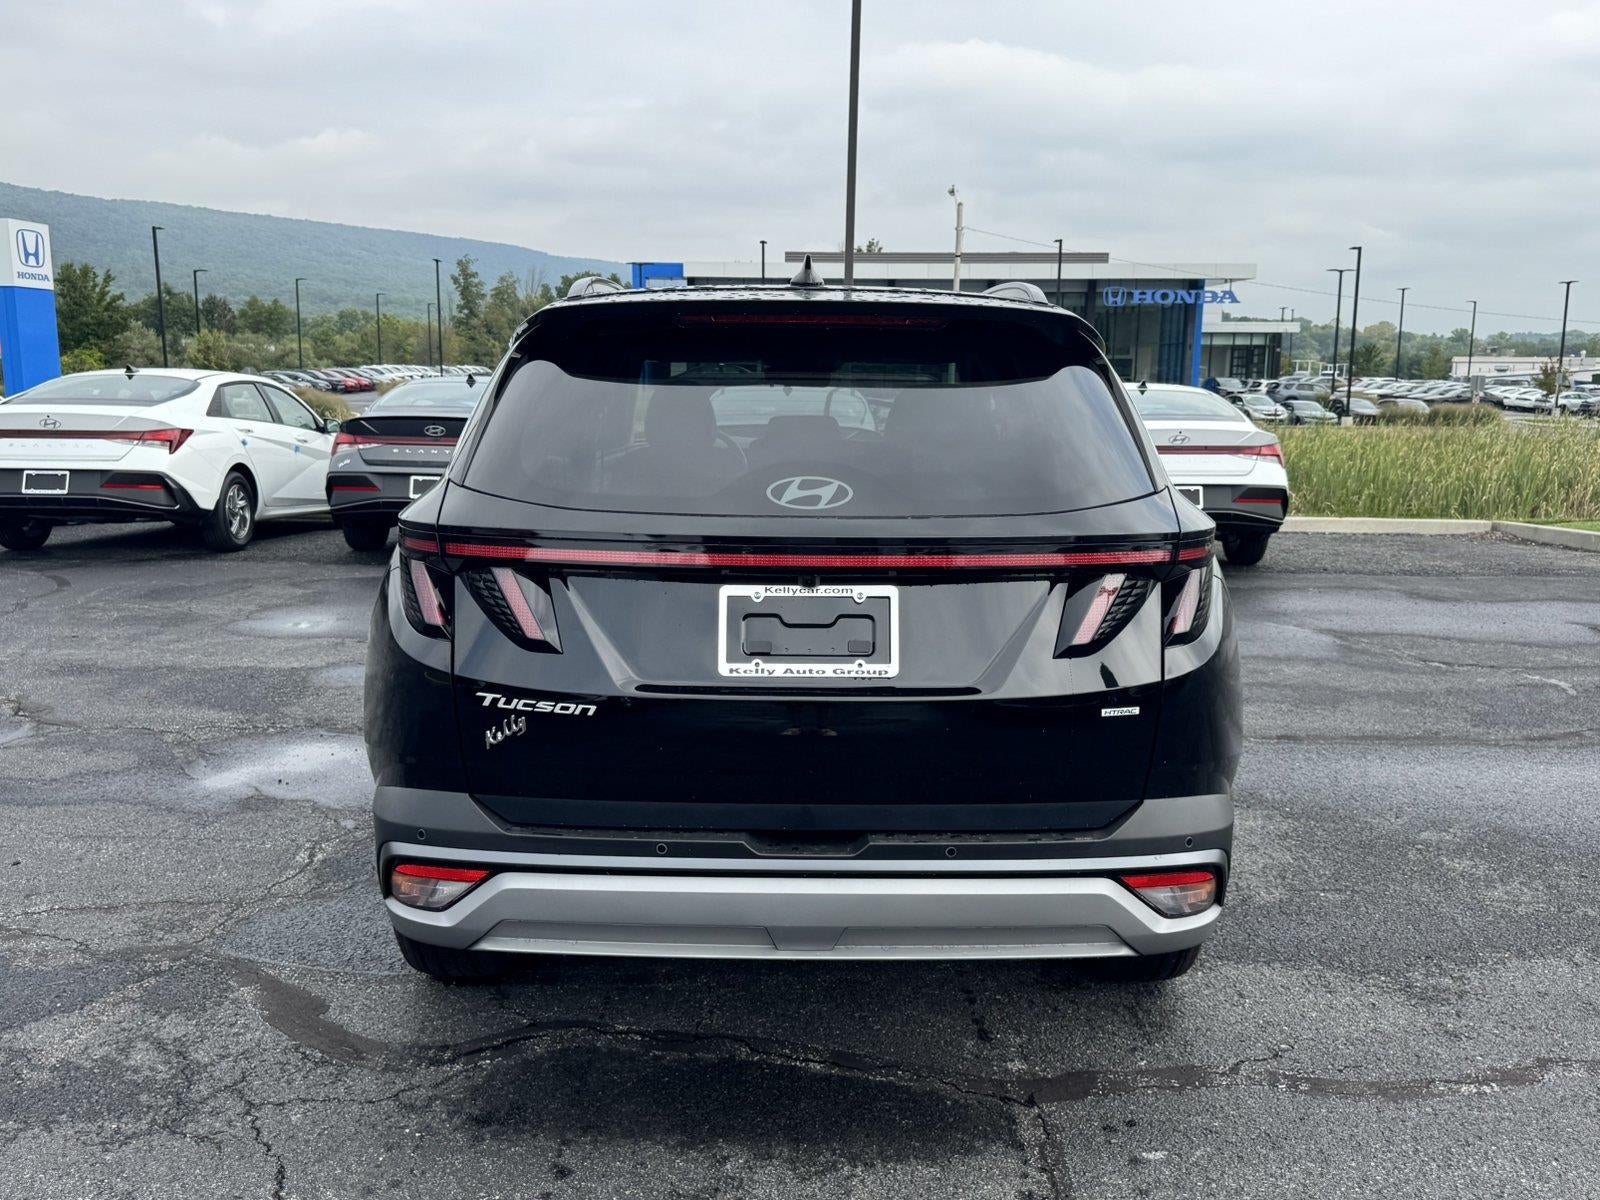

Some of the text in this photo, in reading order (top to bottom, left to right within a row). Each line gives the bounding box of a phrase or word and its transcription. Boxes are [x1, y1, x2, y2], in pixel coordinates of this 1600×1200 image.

[17, 271, 50, 281] HONDA
[1131, 289, 1241, 305] HONDA
[764, 586, 854, 598] Kellycar.com
[728, 667, 890, 676] Kelly Auto Group
[1103, 708, 1138, 716] HTRAC
[485, 714, 527, 750] Kelly
